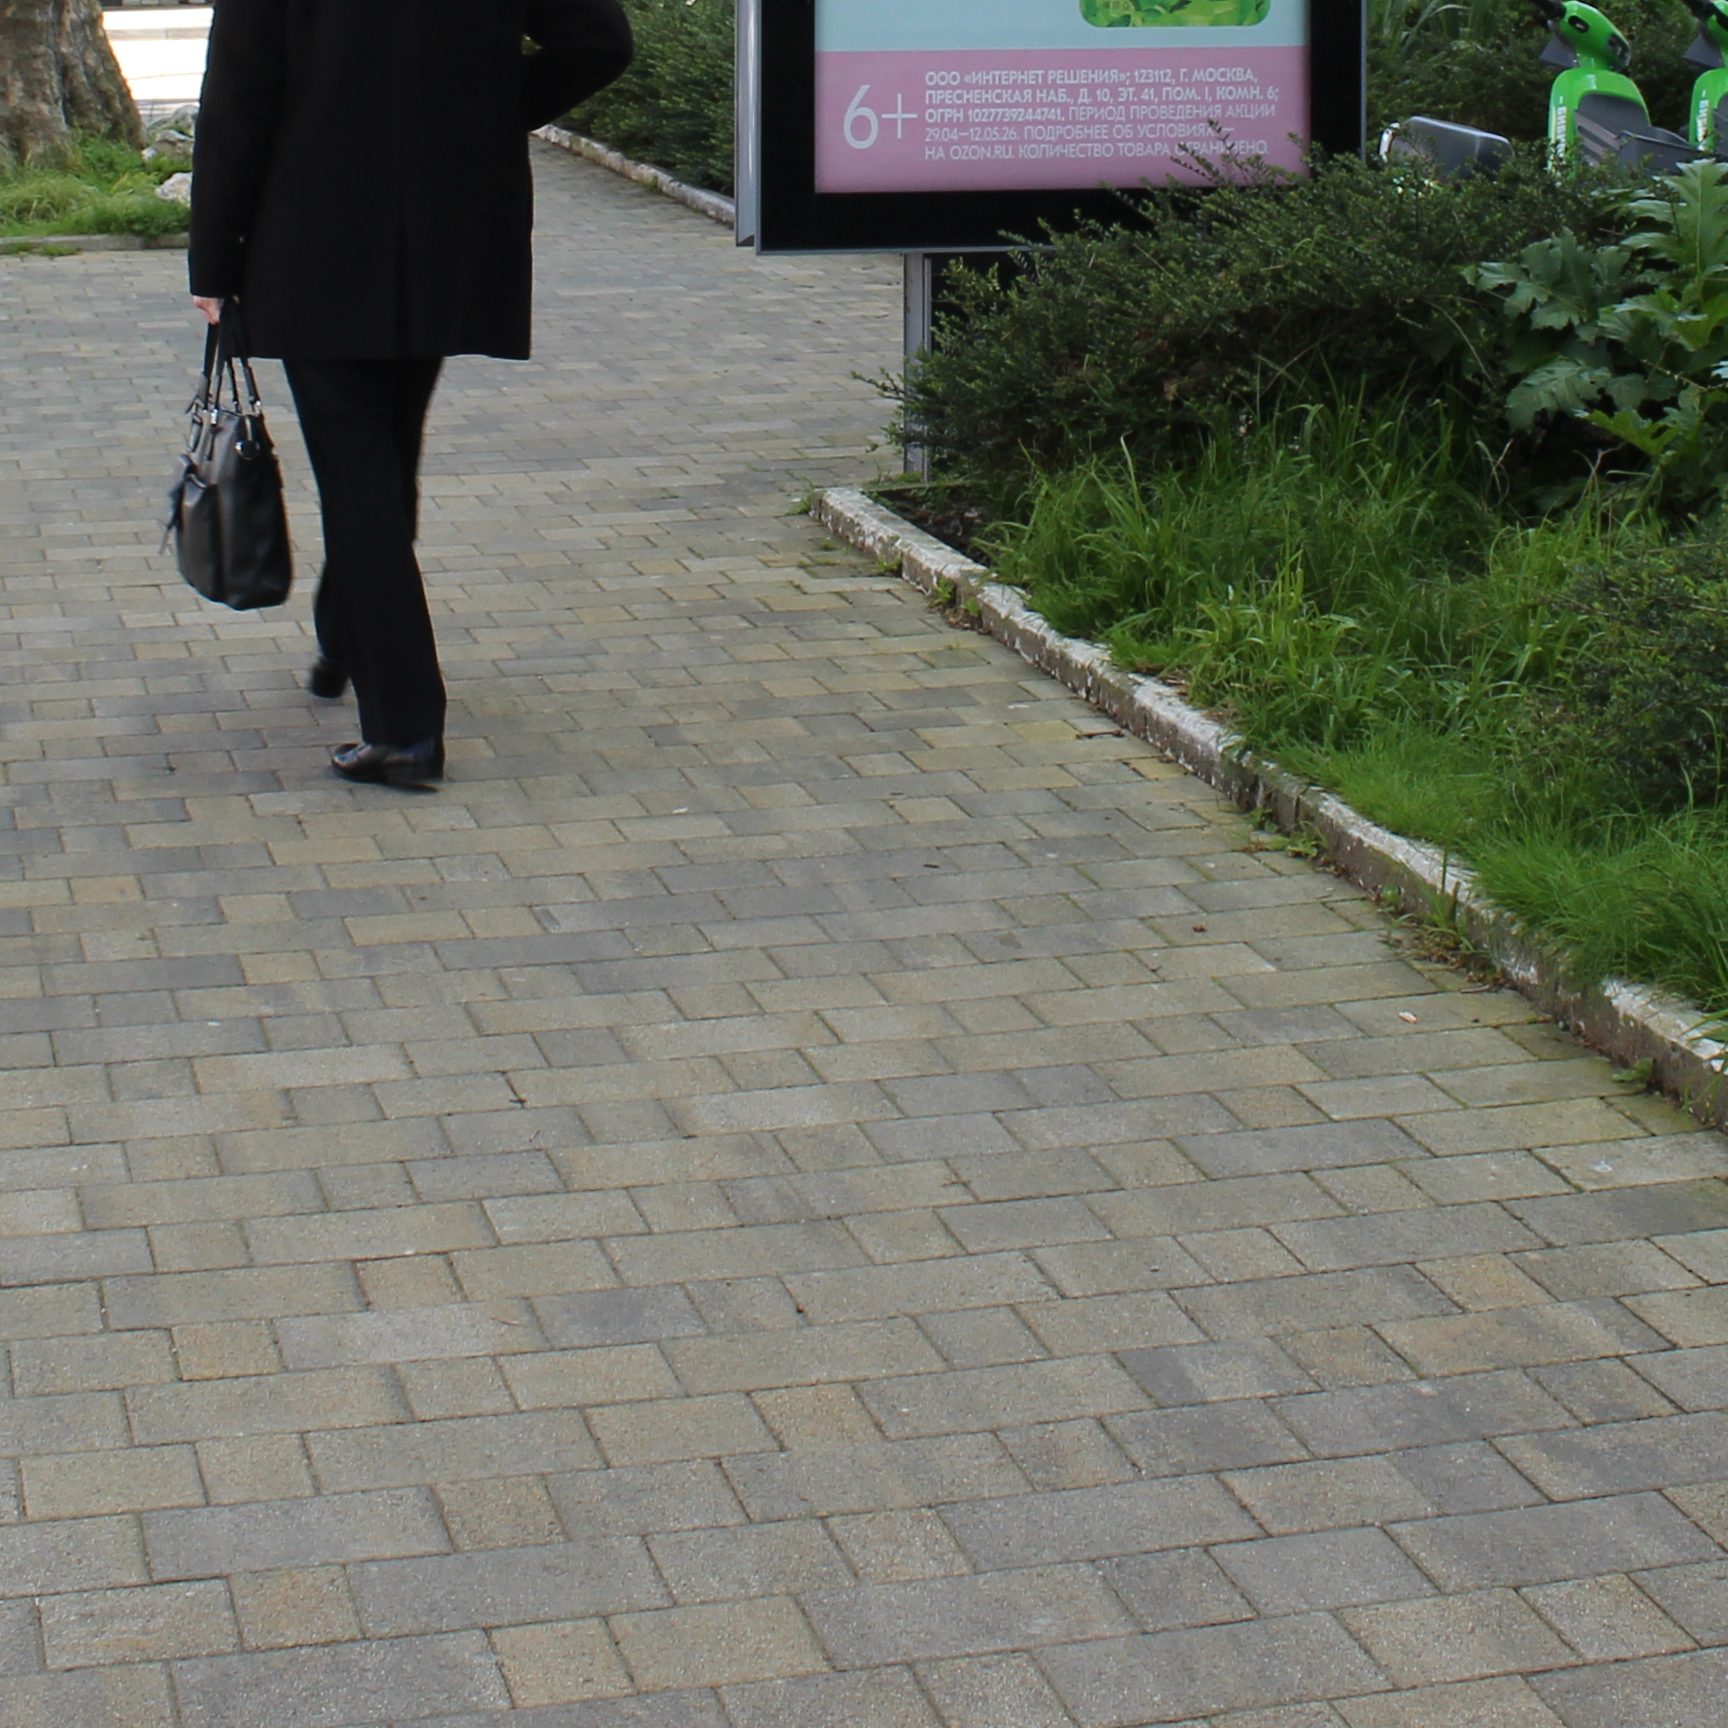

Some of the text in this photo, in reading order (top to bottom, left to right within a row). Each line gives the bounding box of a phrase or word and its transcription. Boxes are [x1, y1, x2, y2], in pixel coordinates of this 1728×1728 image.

[925, 71, 961, 86] ООО
[964, 70, 1046, 86] «ИНТЕРНЕТ
[1047, 69, 1130, 85] РЕШЕНИЯ»;
[1192, 68, 1259, 83] МОСКВА,
[925, 89, 1032, 105] ПРЕСНЕНСКАЯ
[1162, 87, 1202, 102] ПОМ.
[1215, 86, 1264, 101] КОМН.
[843, 84, 918, 150] 6+
[925, 108, 964, 122] ОГРН
[1069, 106, 1126, 121] ПЕРИОД
[1130, 105, 1222, 121] ПРОВЕДЕНИЯ
[1226, 104, 1276, 120] АКЦИИ
[1024, 125, 1109, 142] ПОДРОБНЕЕ
[1113, 124, 1134, 139] ОБ
[1137, 123, 1215, 139] УСЛОВИЯХ
[925, 146, 946, 160] НА
[1019, 143, 1114, 160] КОЛИЧЕСТВО
[1118, 142, 1172, 158] ТОВАРА
